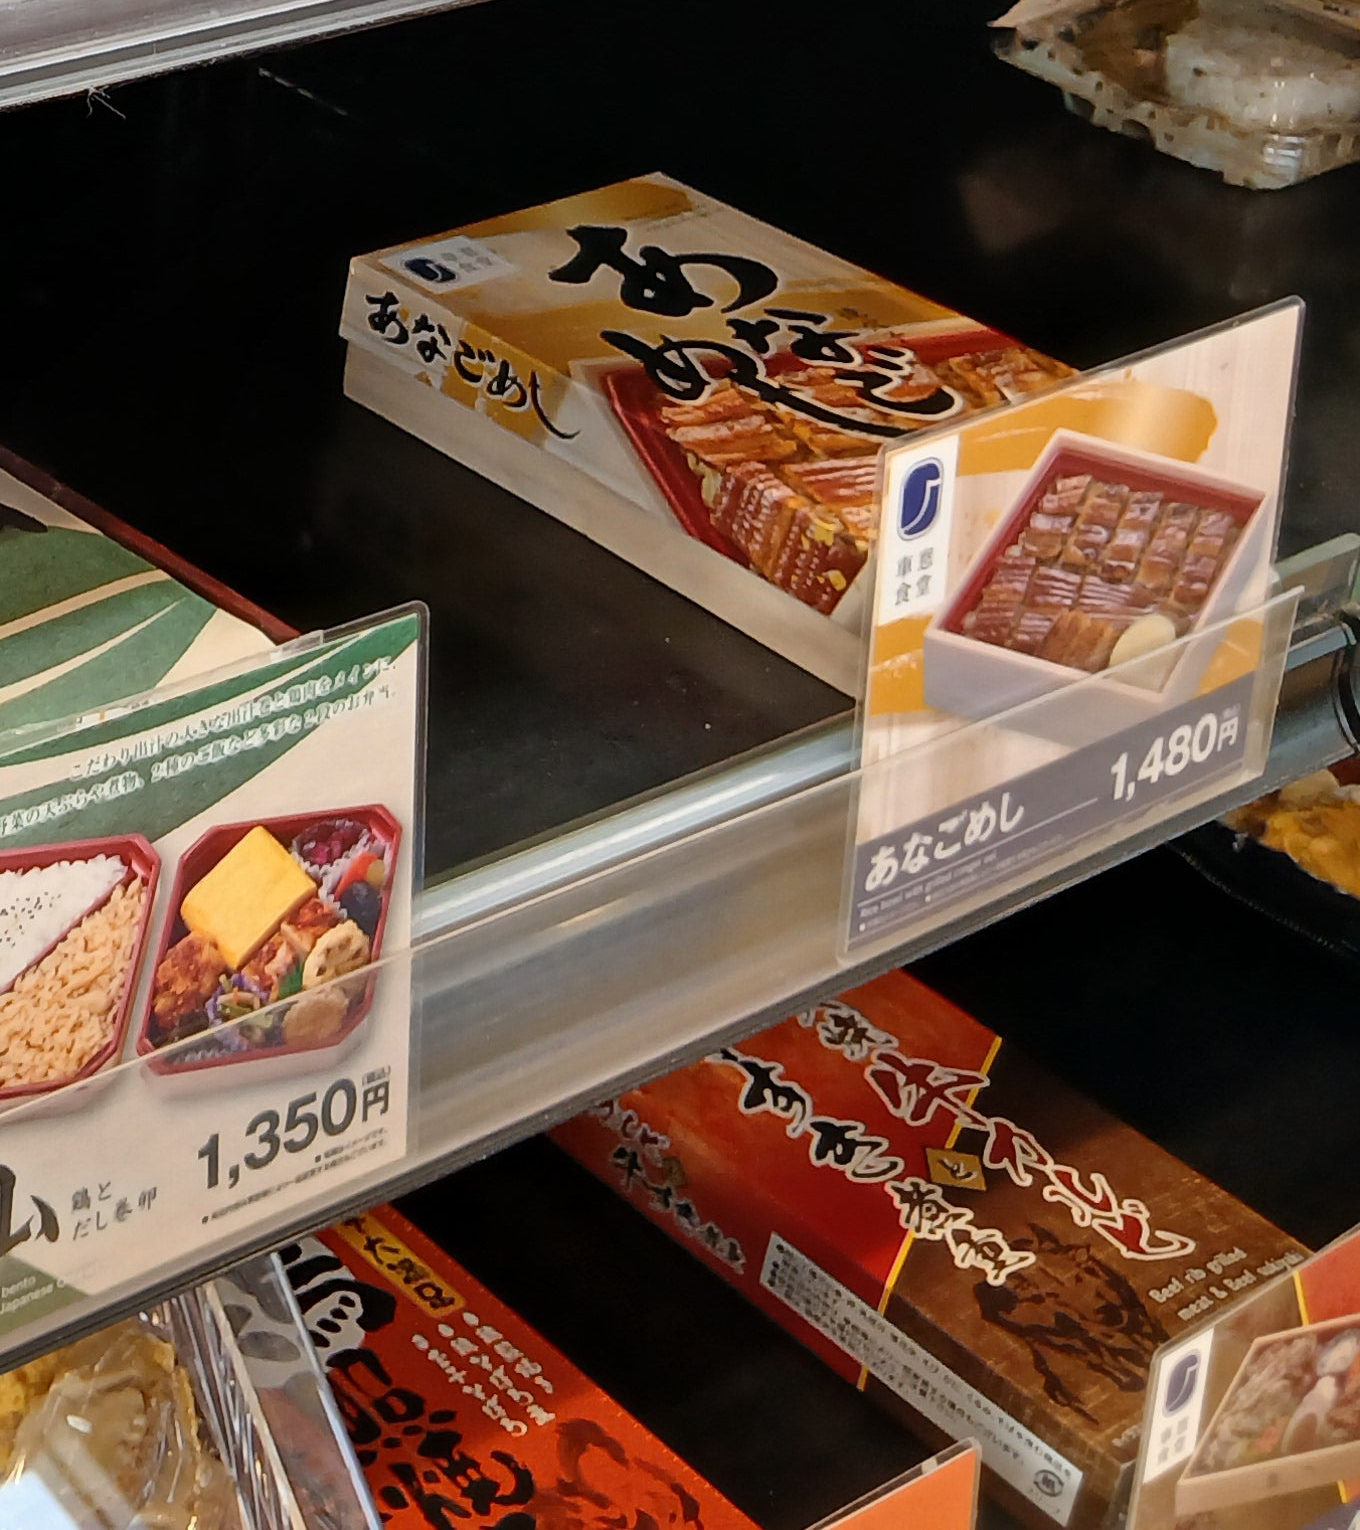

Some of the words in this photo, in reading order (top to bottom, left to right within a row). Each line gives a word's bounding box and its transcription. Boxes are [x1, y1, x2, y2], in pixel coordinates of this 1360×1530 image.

[366, 291, 582, 440] あなごめし
[864, 791, 1025, 893] あなごめし
[197, 1077, 390, 1191] 1,350円
[2, 1275, 37, 1299] bento
[1149, 1276, 1184, 1303] Beef
